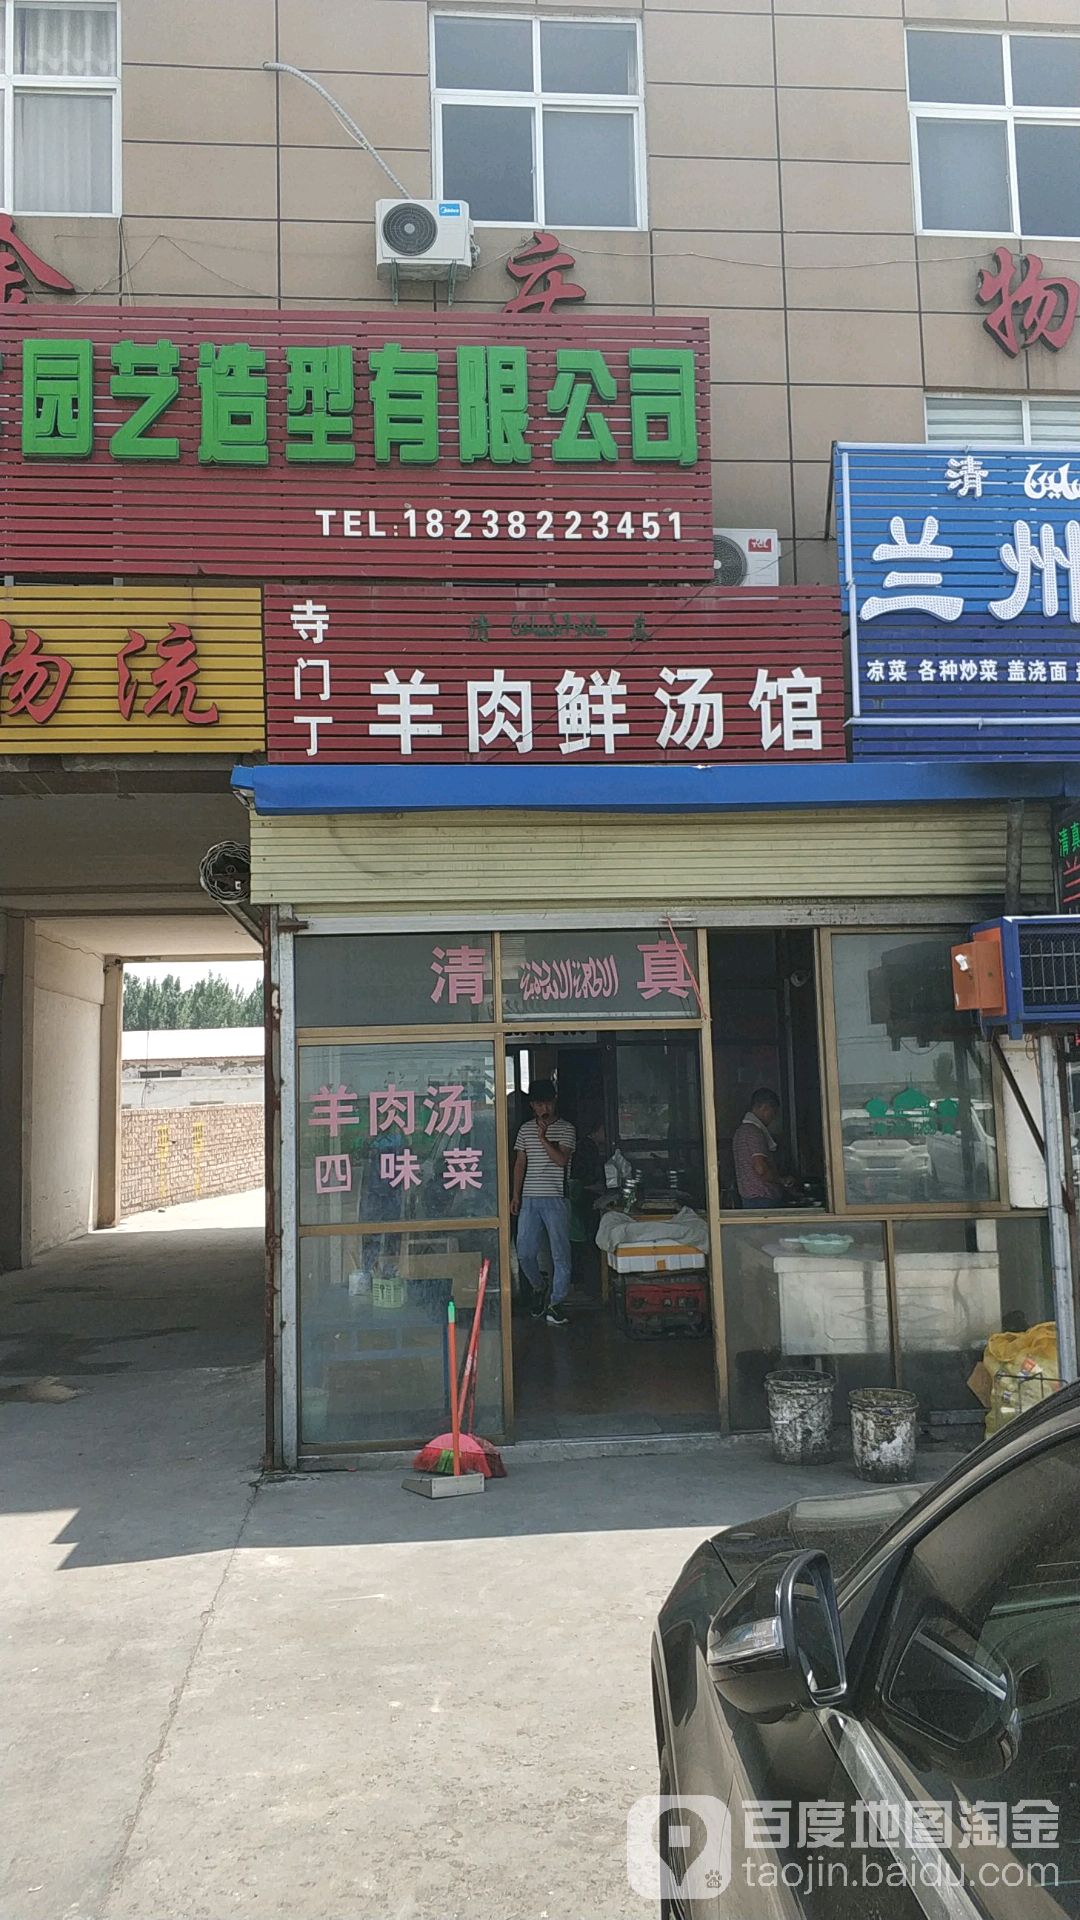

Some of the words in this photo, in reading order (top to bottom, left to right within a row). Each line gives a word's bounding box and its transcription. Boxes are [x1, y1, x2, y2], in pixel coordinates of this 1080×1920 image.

[976, 246, 1080, 358] 物
[22, 339, 698, 466] 园艺造型有限公司
[945, 456, 989, 498] 清
[315, 508, 681, 540] TEL:18238223451
[860, 516, 1080, 623] 兰州
[0, 619, 220, 725] 物流
[290, 600, 333, 757] 寺门丁
[866, 659, 907, 682] 凉菜
[918, 659, 998, 682] 各种炒菜
[1007, 659, 1067, 682] 盖浇面
[369, 667, 822, 755] 羊肉鲜汤馆
[430, 945, 487, 1005] 清
[636, 939, 693, 1000] 真
[308, 1084, 473, 1137] 羊肉汤
[315, 1147, 483, 1194] 四味菜
